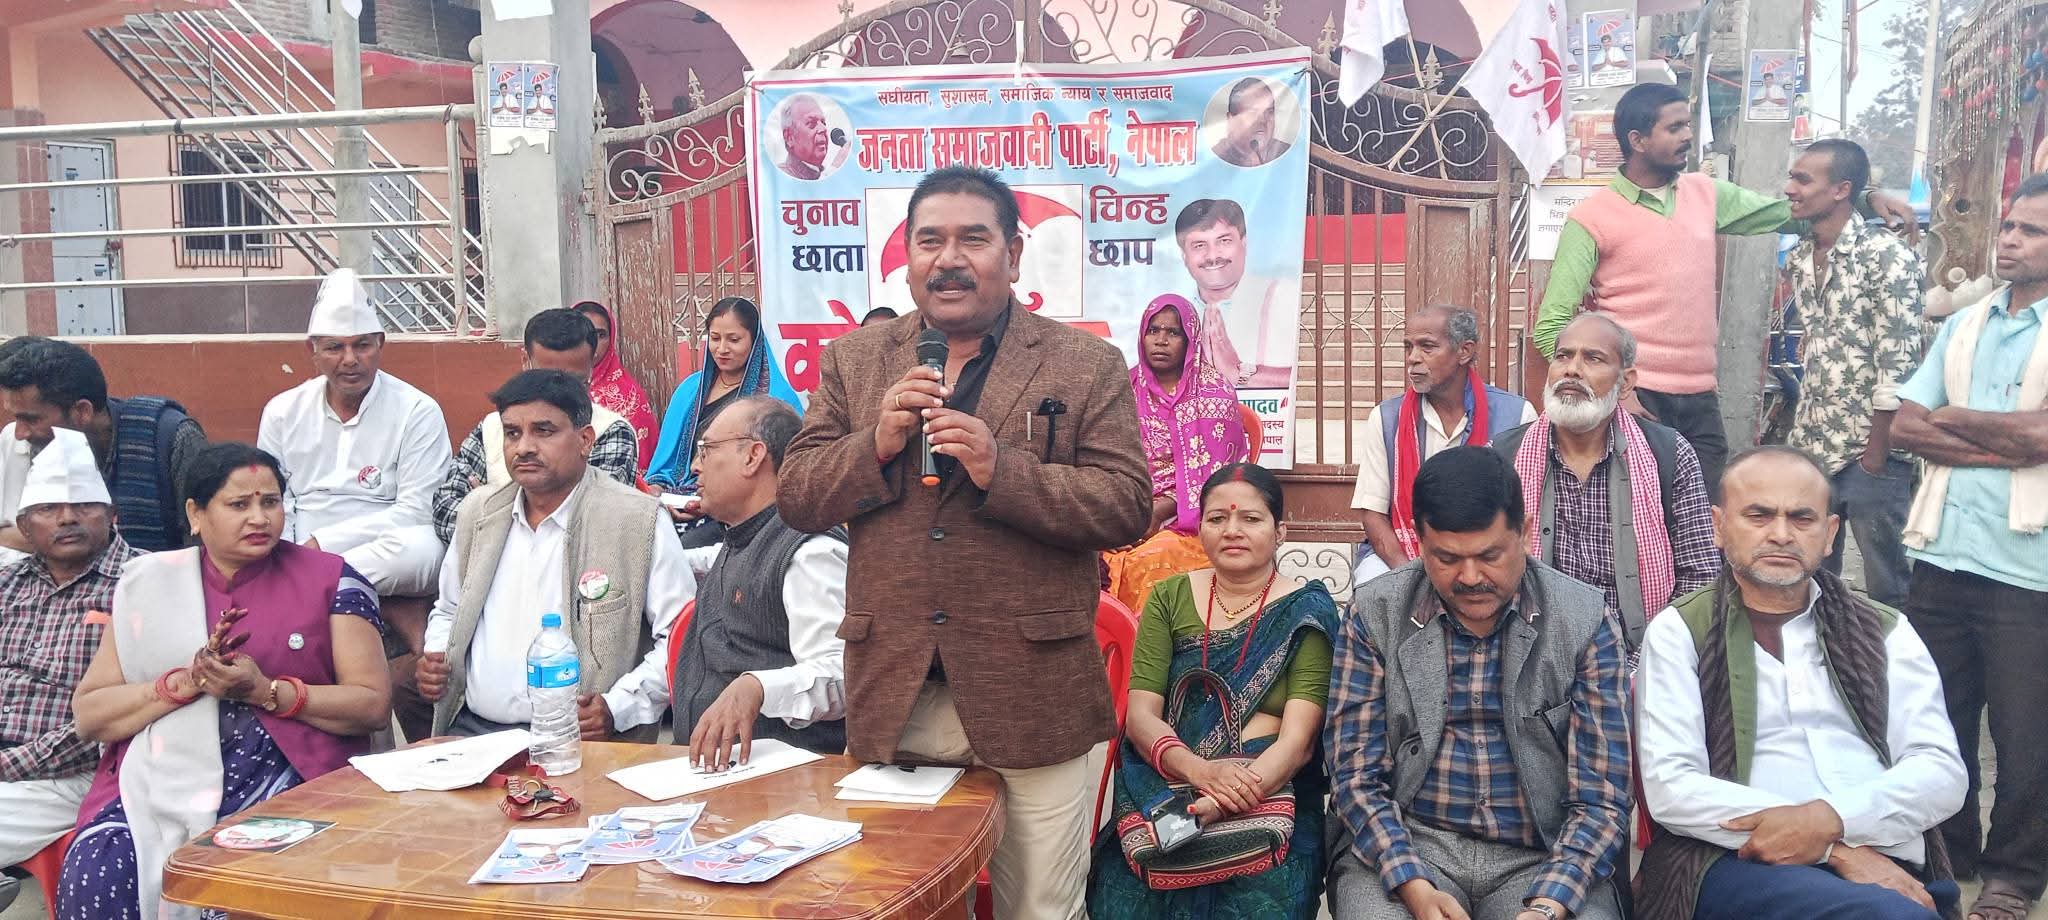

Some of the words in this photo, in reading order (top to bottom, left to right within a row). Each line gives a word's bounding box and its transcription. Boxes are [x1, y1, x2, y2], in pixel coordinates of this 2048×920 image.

[1062, 87, 1091, 101] न्याय
[1096, 87, 1107, 101] र
[1113, 85, 1174, 102] समाजवाद
[856, 127, 926, 172] जनता
[930, 111, 1053, 170] समाजवादी
[1058, 109, 1120, 177] पार्टी,
[1126, 109, 1197, 166] नेपाल
[780, 199, 861, 236] चुनाव
[1089, 185, 1170, 225] चिन्ह
[791, 244, 866, 273] छाता
[1088, 238, 1156, 268] छाप
